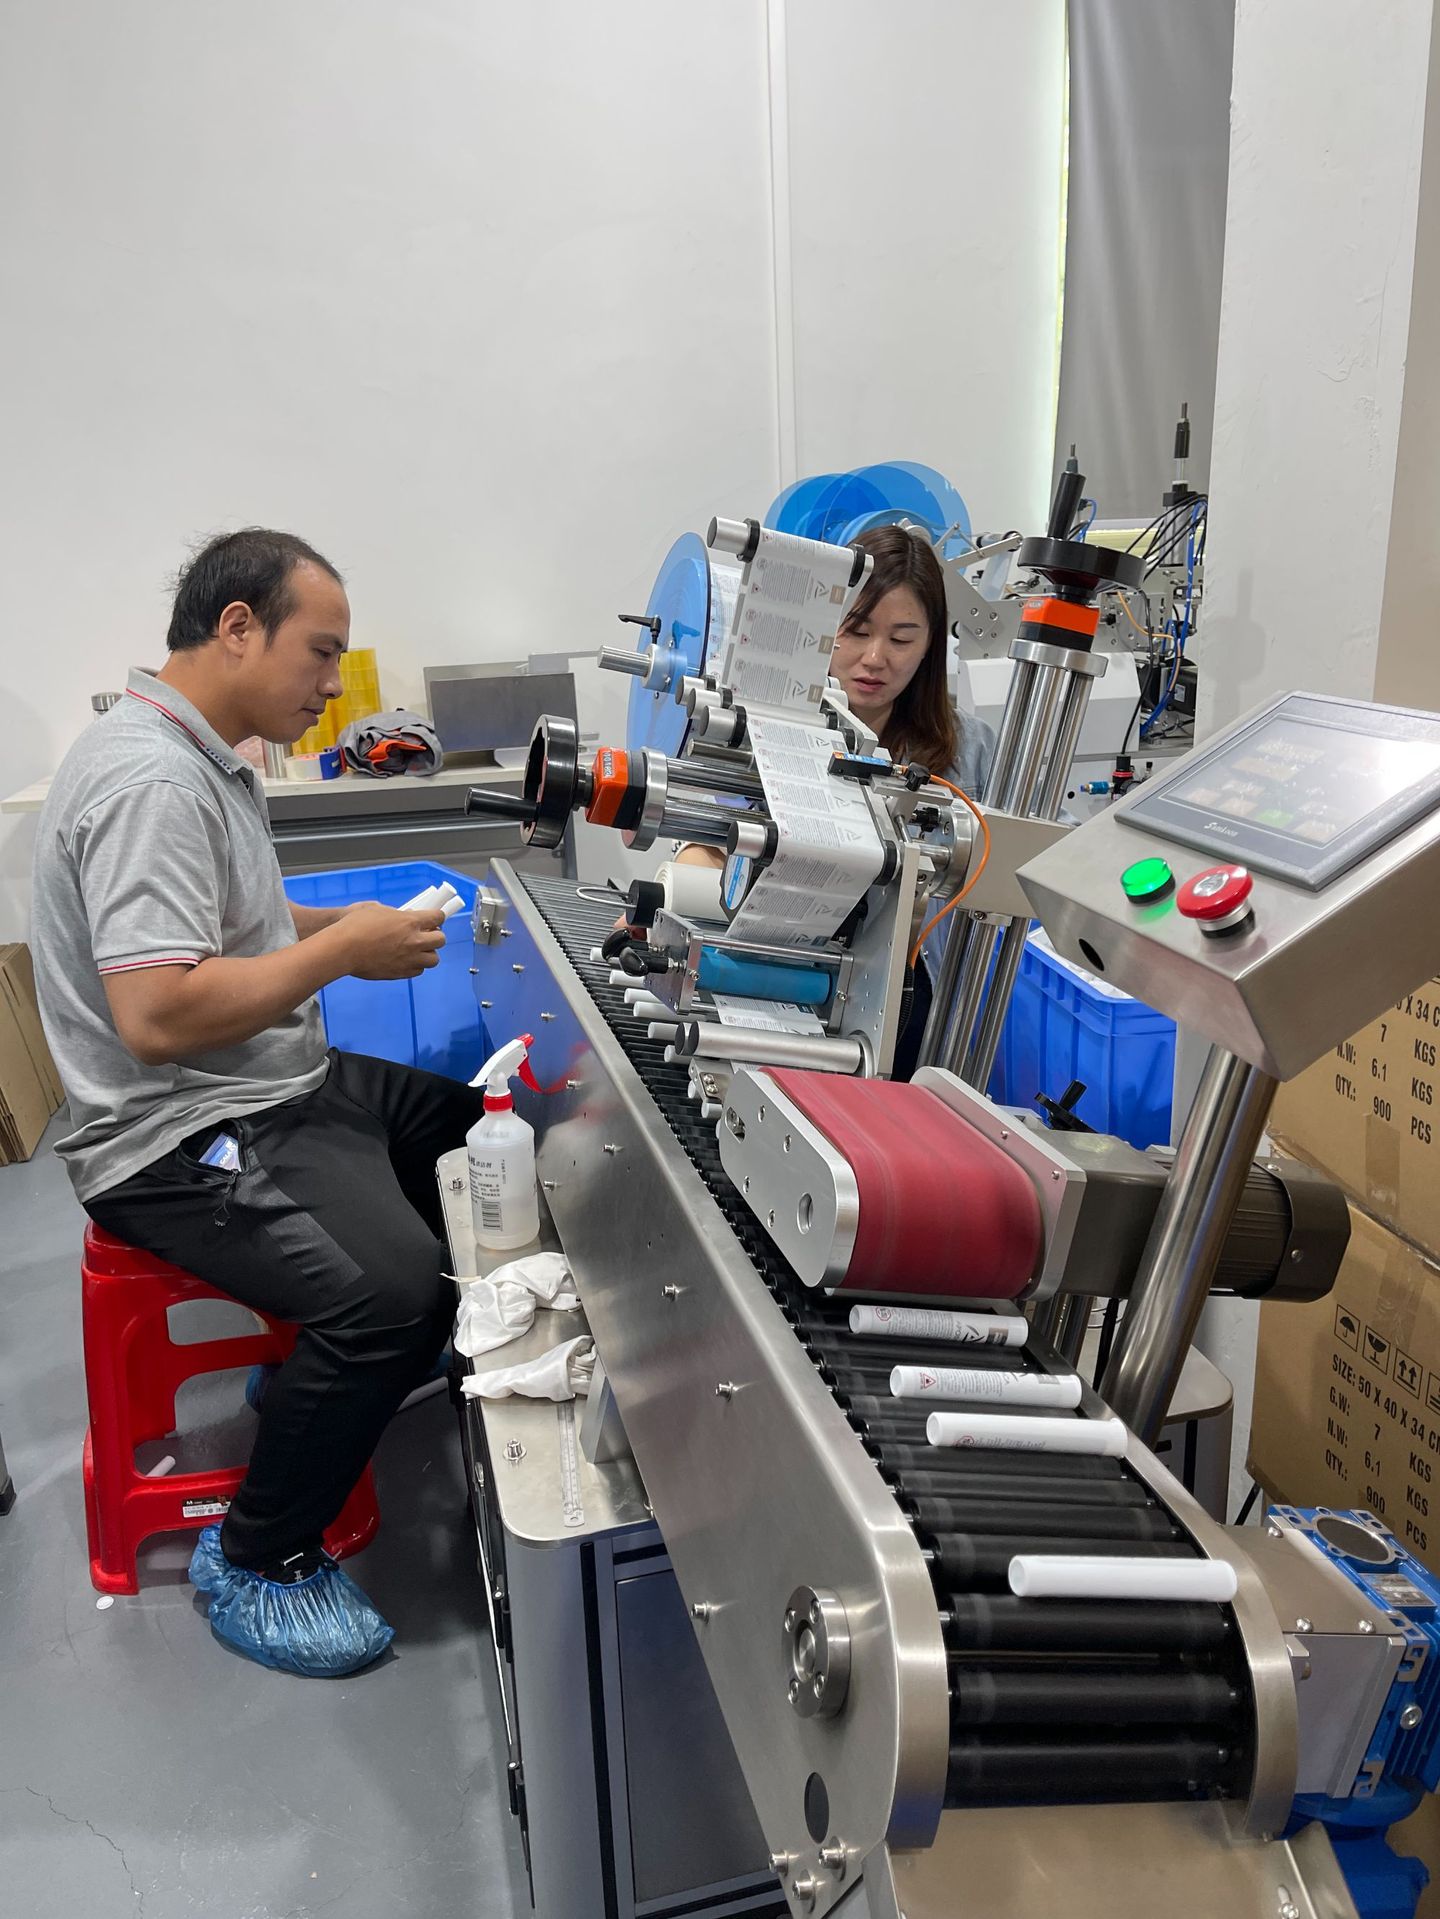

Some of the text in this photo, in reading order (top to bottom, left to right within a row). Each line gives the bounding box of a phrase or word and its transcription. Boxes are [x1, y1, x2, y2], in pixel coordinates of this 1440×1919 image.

[1381, 1024, 1436, 1067] 7 KGS
[1406, 995, 1413, 1016] X
[1416, 999, 1430, 1022] 34
[1336, 1074, 1432, 1145] QTY.: 900 PCS
[1372, 1058, 1387, 1082] 6.1
[1411, 1077, 1433, 1106] KGS
[1329, 1386, 1432, 1484] G.W: 7 KGS
[1332, 1354, 1356, 1387] SIZE:
[1359, 1375, 1371, 1398] 50
[1374, 1387, 1381, 1408] X
[1384, 1397, 1397, 1420] 40
[1400, 1407, 1408, 1428] X
[1411, 1418, 1425, 1442] 34
[1326, 1449, 1428, 1551] QTY.: 900 PCS
[1327, 1417, 1428, 1517] N.W: 6.1 KGS
